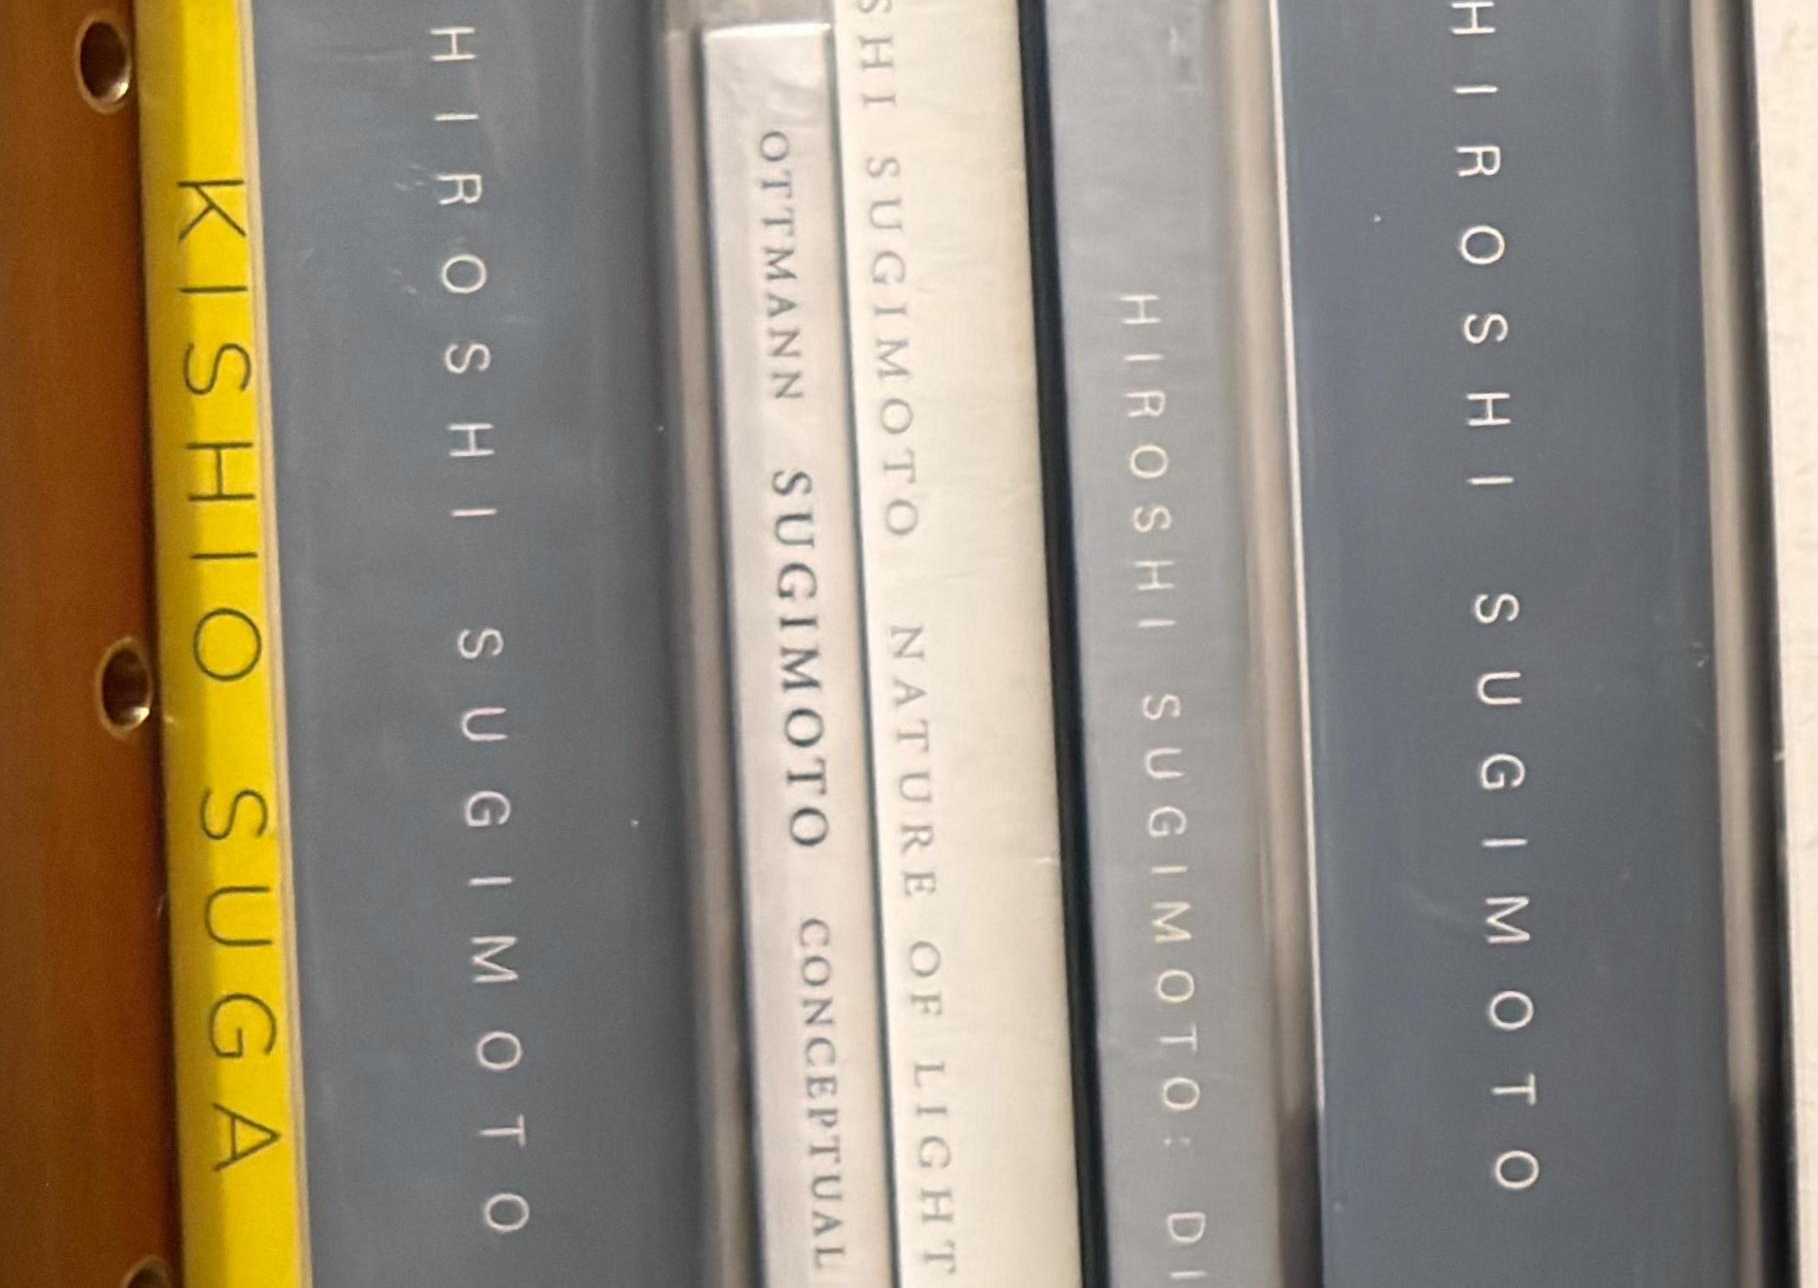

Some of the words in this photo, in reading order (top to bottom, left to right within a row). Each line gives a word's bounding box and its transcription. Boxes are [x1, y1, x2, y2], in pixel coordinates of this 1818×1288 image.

[175, 176, 263, 683] KISHIO
[428, 22, 498, 519] HIROSHI
[756, 127, 805, 402] OTTMANN
[864, 153, 922, 537] SUGIMOTO
[1119, 289, 1176, 631] HIROSHI
[771, 467, 831, 851] SUGIMOTO
[890, 622, 939, 900] NATURE
[197, 786, 282, 1173] SUGA
[454, 626, 531, 1233] SUGIMOTO
[906, 939, 945, 1020] OF
[1471, 590, 1542, 1191] SUGIMOTO
[796, 917, 847, 1268] CONCEPTUAL
[911, 1062, 959, 1275] LIGHT
